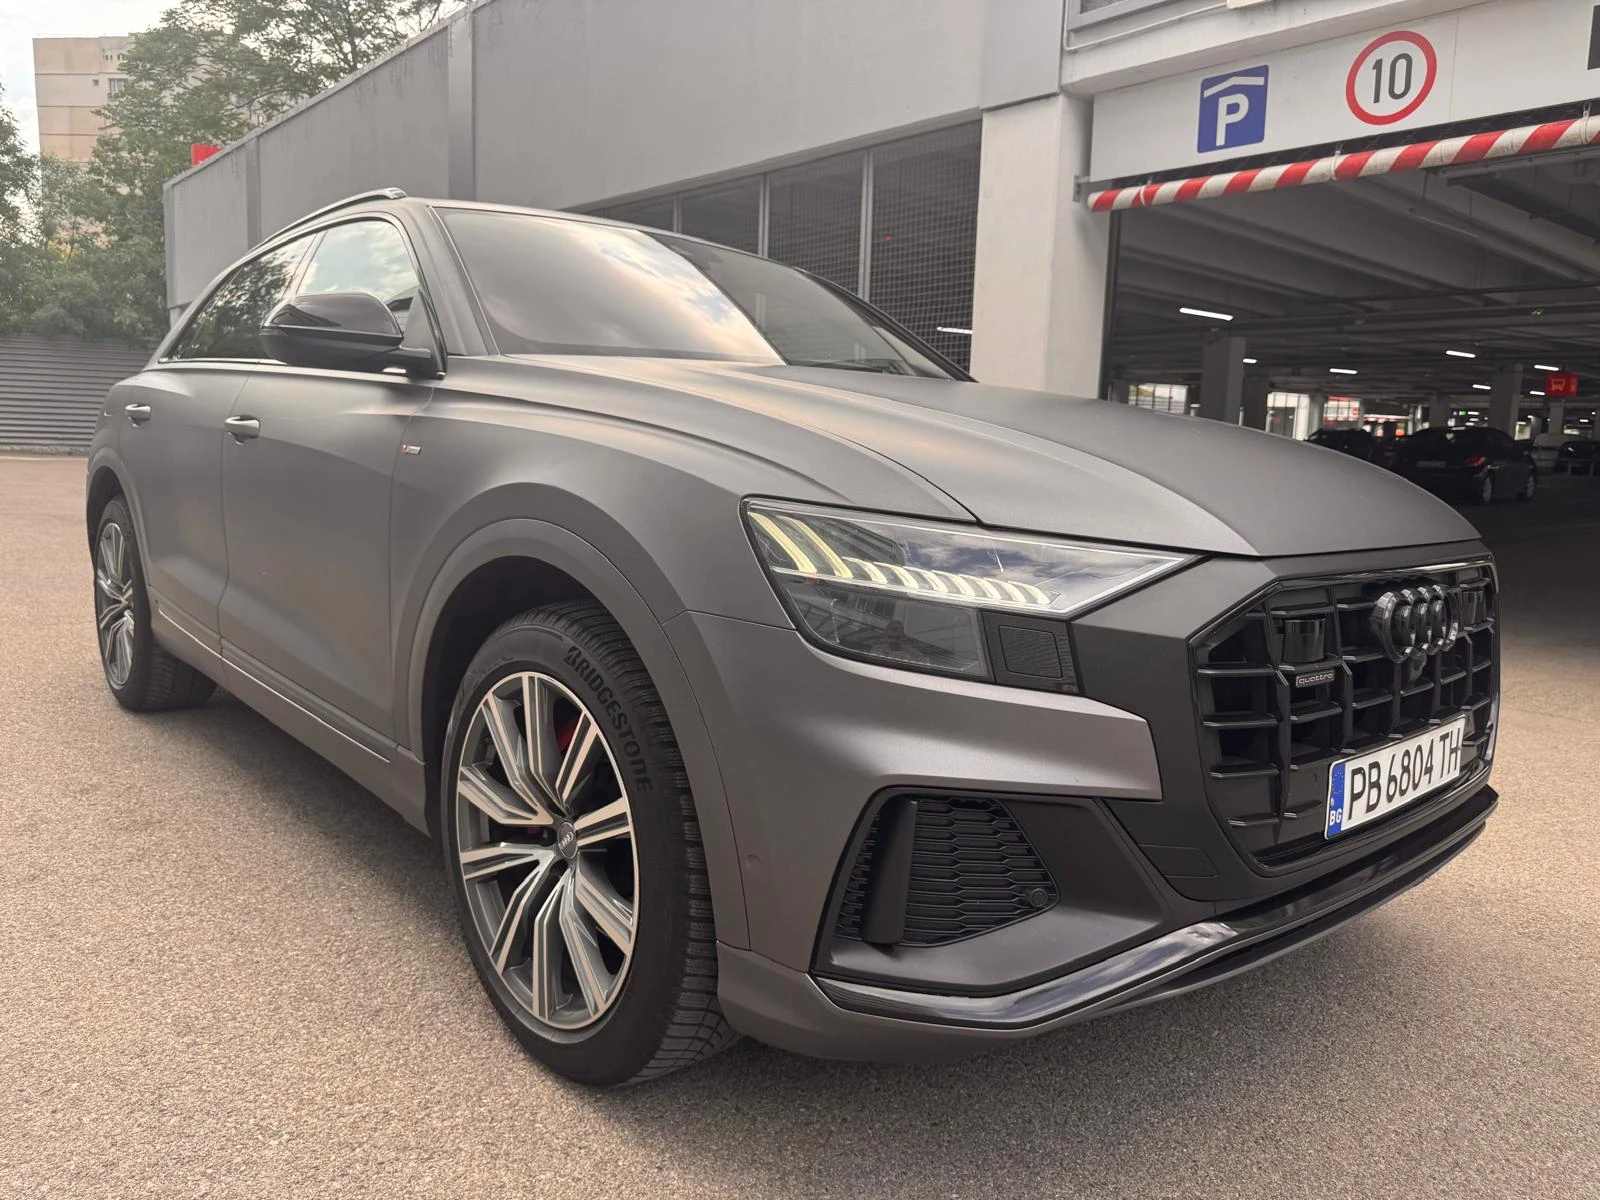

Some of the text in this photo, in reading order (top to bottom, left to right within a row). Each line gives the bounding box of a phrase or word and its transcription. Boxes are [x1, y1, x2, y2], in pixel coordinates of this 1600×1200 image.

[1372, 53, 1412, 103] 10
[1216, 93, 1249, 146] P
[1298, 673, 1334, 685] quattro
[562, 645, 653, 791] BRIDGESTONE
[1347, 727, 1461, 820] PB 6804 TH
[1329, 808, 1342, 826] BG
